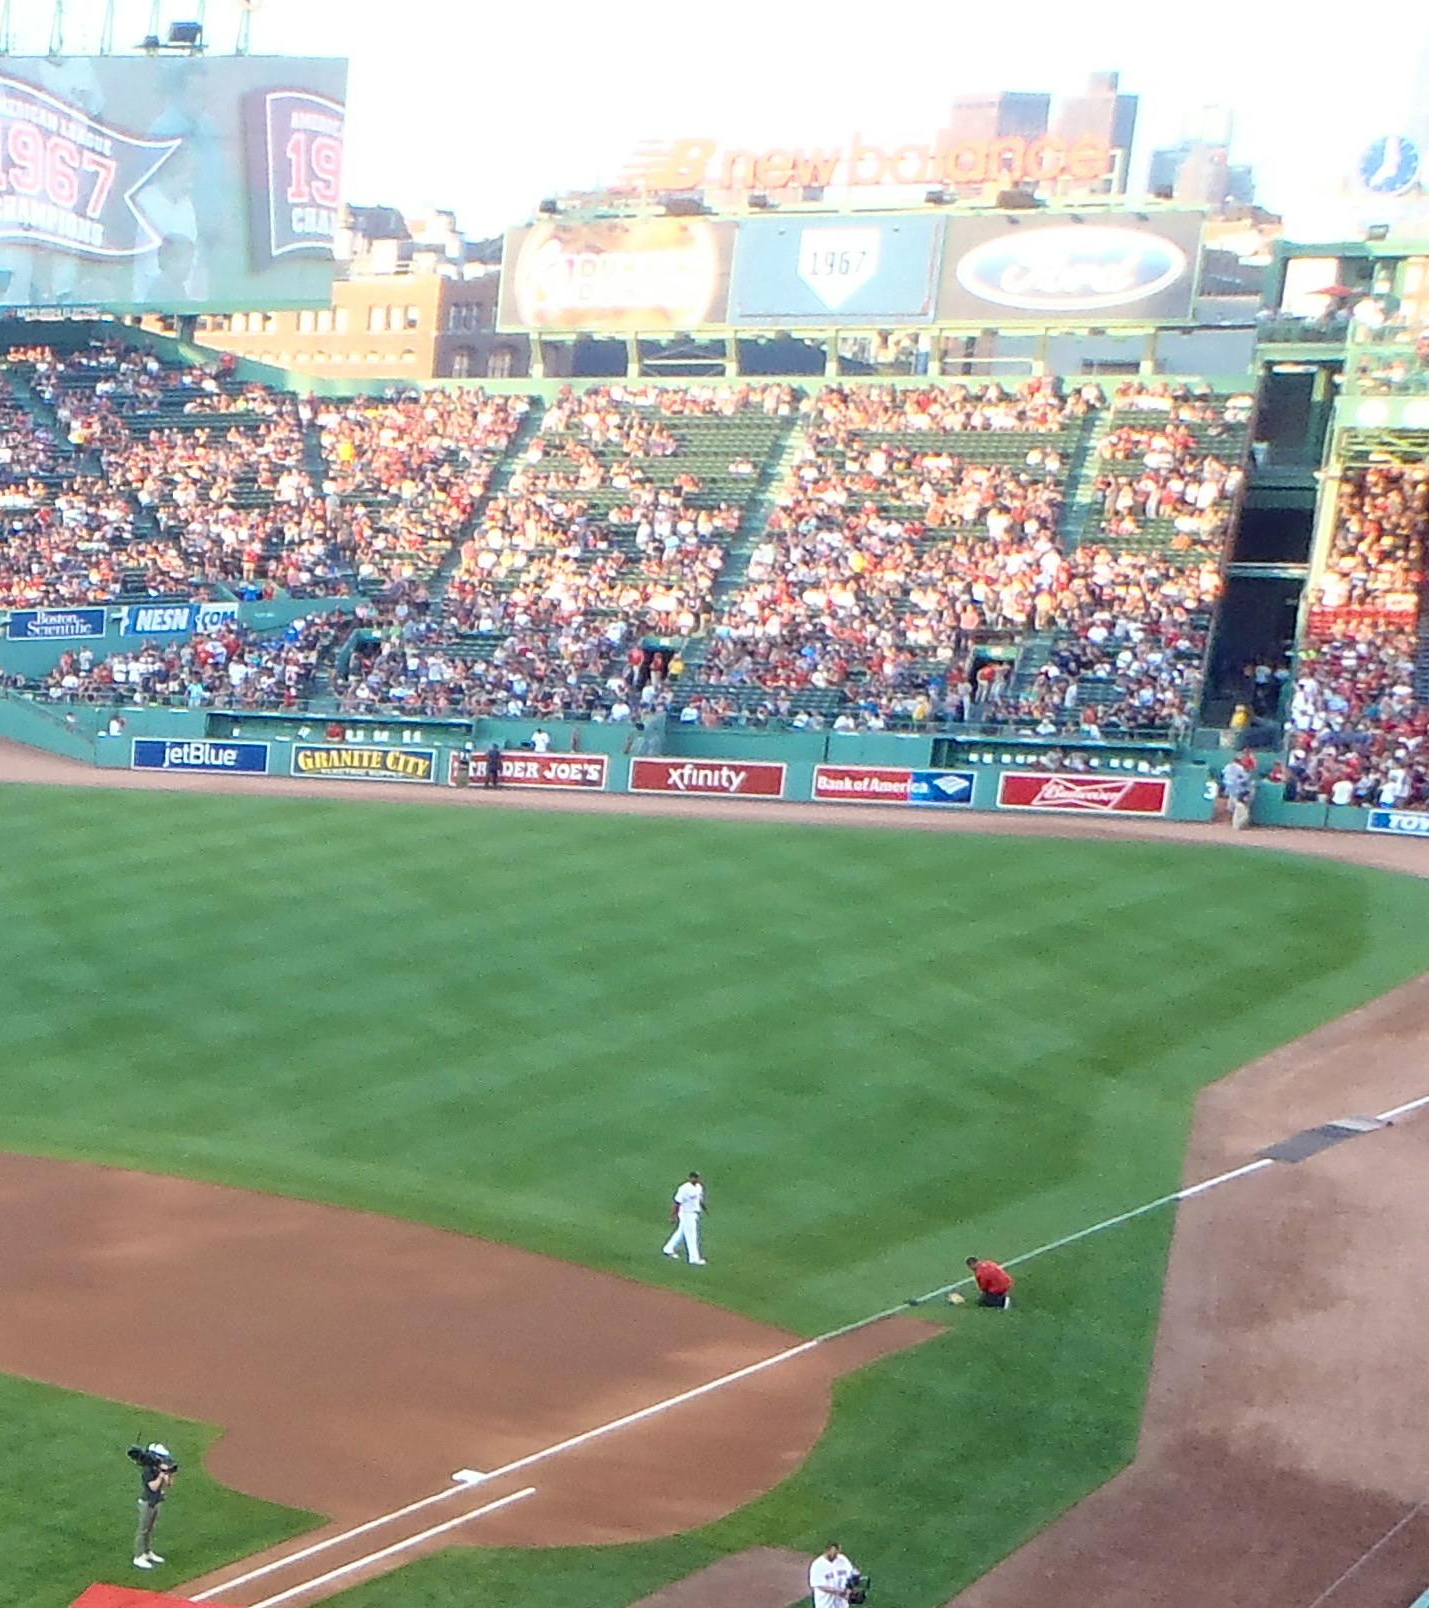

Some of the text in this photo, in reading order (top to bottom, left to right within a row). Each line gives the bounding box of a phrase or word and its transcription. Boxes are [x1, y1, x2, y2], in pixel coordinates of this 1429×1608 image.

[722, 131, 1111, 189] new balance
[809, 250, 867, 276] 1967
[999, 248, 1141, 294] Ford
[27, 621, 93, 637] Scientific
[35, 610, 79, 626] Boston
[135, 607, 190, 632] NESN
[162, 742, 237, 768] jetBlue
[297, 747, 430, 777] GRANITE CITY
[467, 760, 603, 781] TRDER JOE'S
[667, 765, 747, 792] xfinity
[816, 775, 930, 795] Bank America
